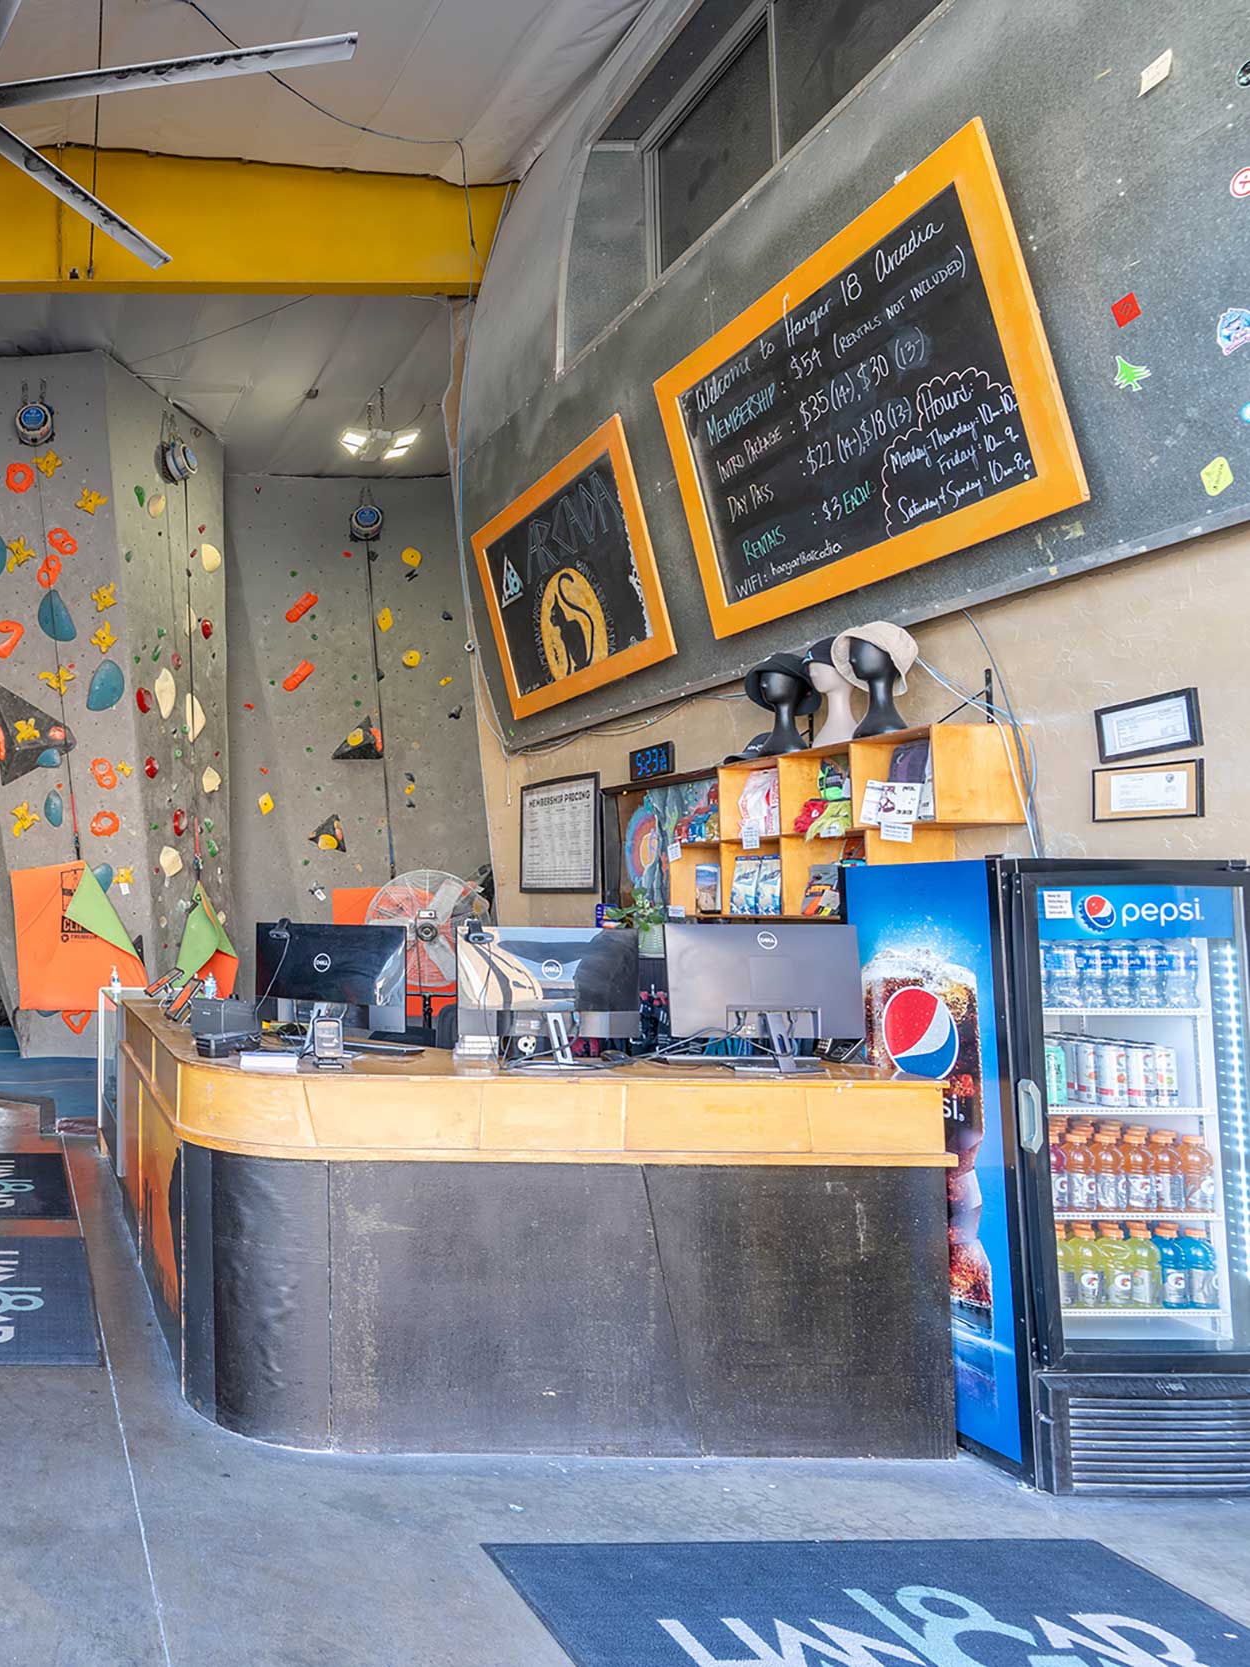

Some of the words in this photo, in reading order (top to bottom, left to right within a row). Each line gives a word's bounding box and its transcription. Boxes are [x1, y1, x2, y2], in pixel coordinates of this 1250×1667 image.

[696, 357, 753, 412] Welcome
[759, 339, 776, 360] to
[783, 292, 832, 348] Hangar
[840, 273, 862, 306] 18
[875, 222, 945, 282] Arcadia
[706, 383, 777, 446] MEMBERSHIP
[790, 347, 822, 379] $54
[833, 315, 882, 358] (RENTALS
[885, 296, 905, 320] NOT
[910, 245, 966, 302] INCLUDED)
[716, 455, 746, 484] INTRO
[727, 494, 747, 523] DAY
[749, 483, 775, 510] PASS
[742, 525, 786, 565] RENTALS
[822, 496, 842, 521] $3
[528, 793, 564, 809] MEMBERSHIP
[564, 790, 591, 802] PRICING
[1122, 898, 1202, 927] pepsi
